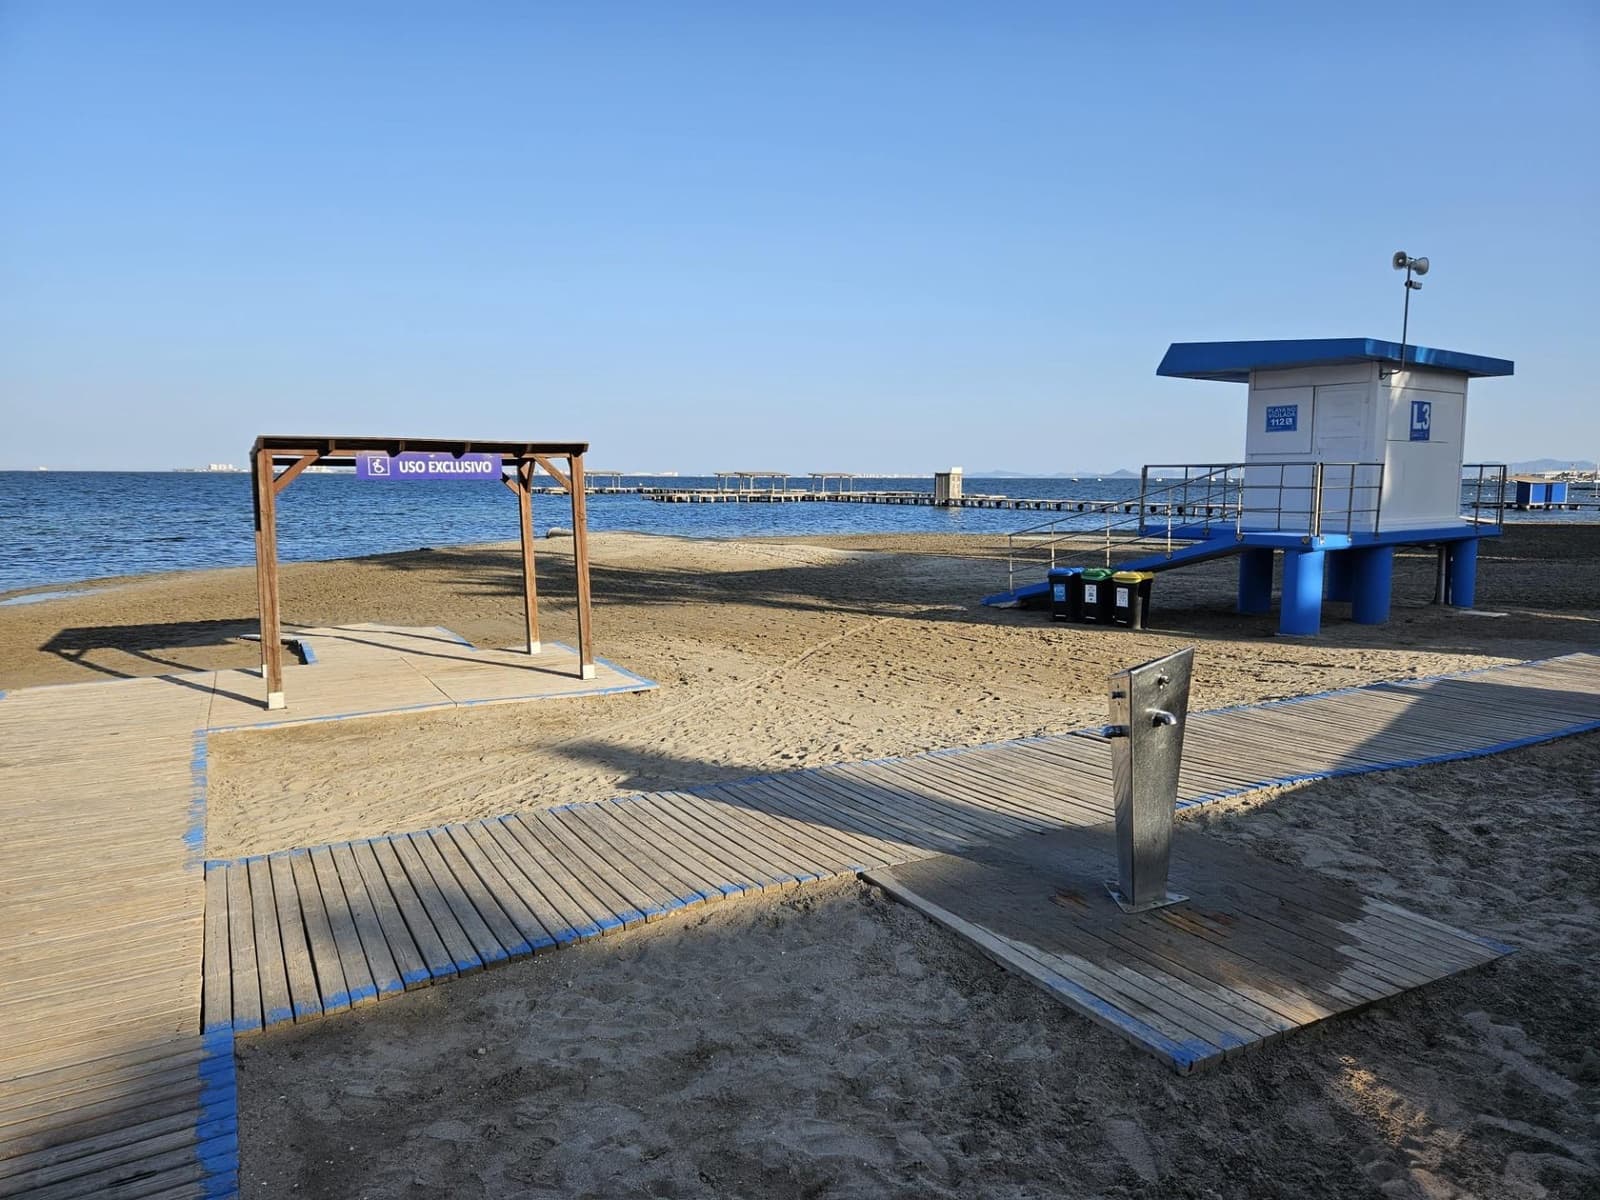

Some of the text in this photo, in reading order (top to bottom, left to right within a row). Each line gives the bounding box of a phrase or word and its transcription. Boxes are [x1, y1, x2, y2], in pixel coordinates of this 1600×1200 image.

[1271, 418, 1285, 426] 112
[1413, 404, 1430, 430] L3
[399, 461, 492, 473] USO EXCLUSIVO
